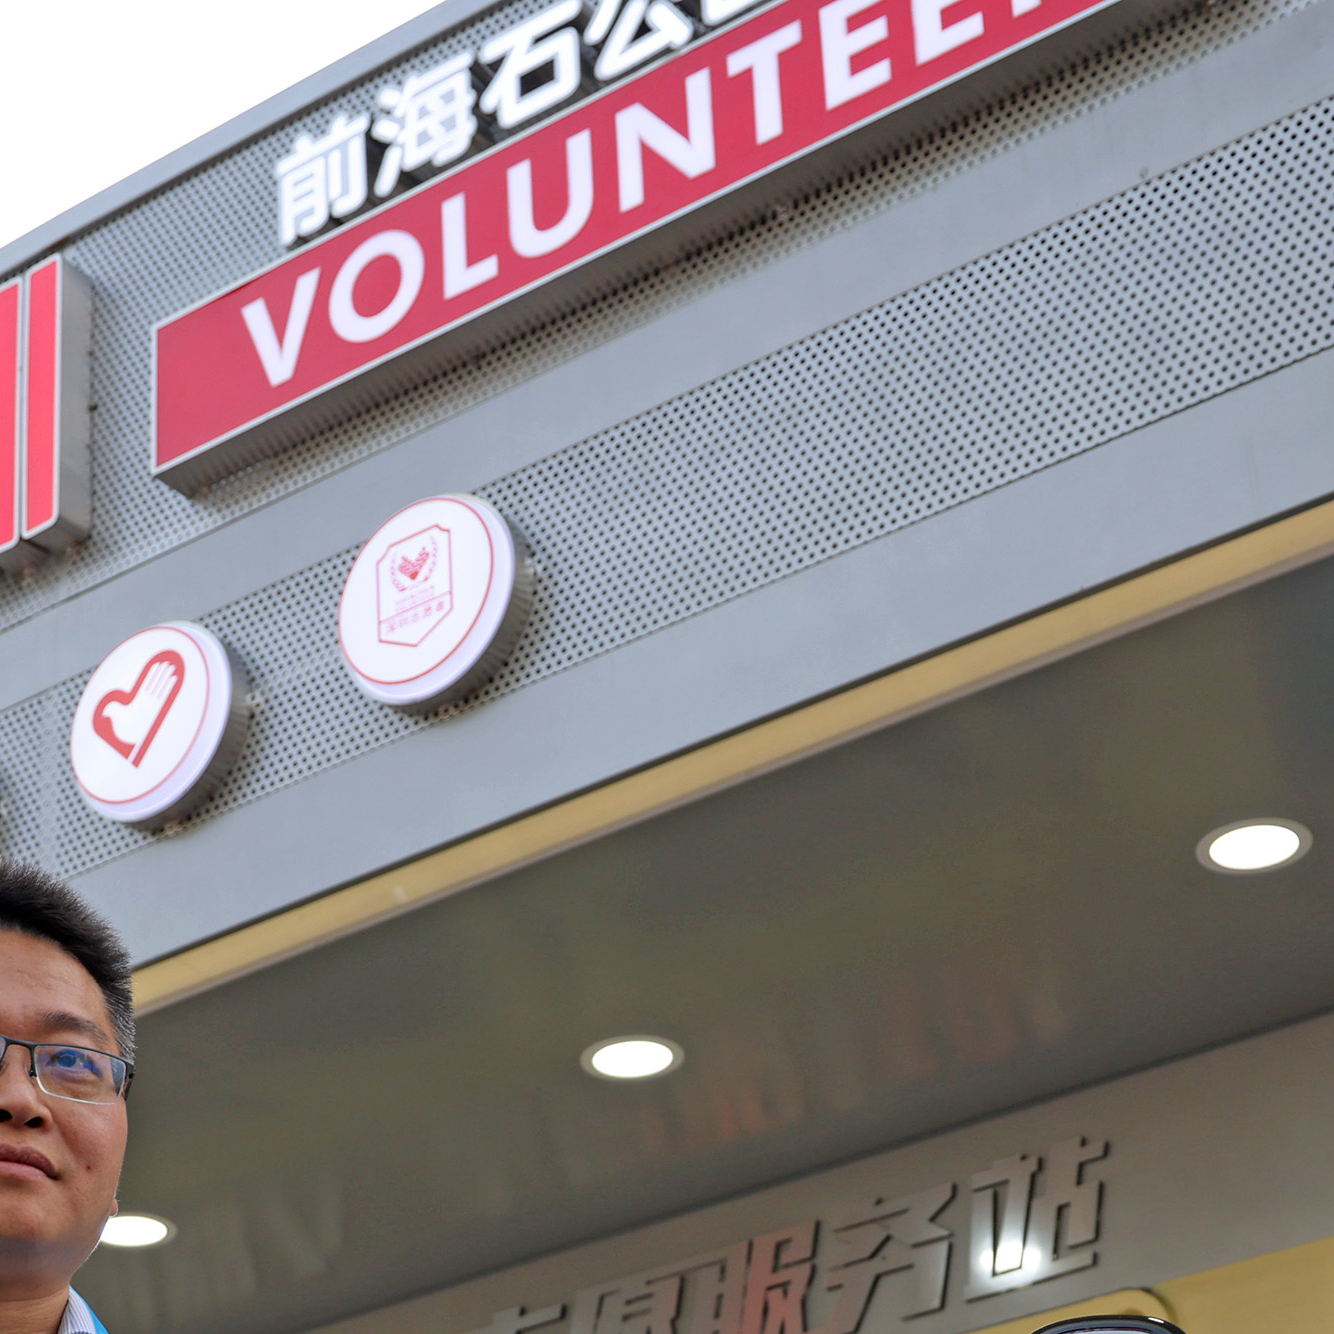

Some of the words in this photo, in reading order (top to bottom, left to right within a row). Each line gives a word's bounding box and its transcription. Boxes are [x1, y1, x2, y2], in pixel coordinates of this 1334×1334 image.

[241, 0, 1043, 388] VOLUNTEE
[275, 0, 779, 246] 前海石公
